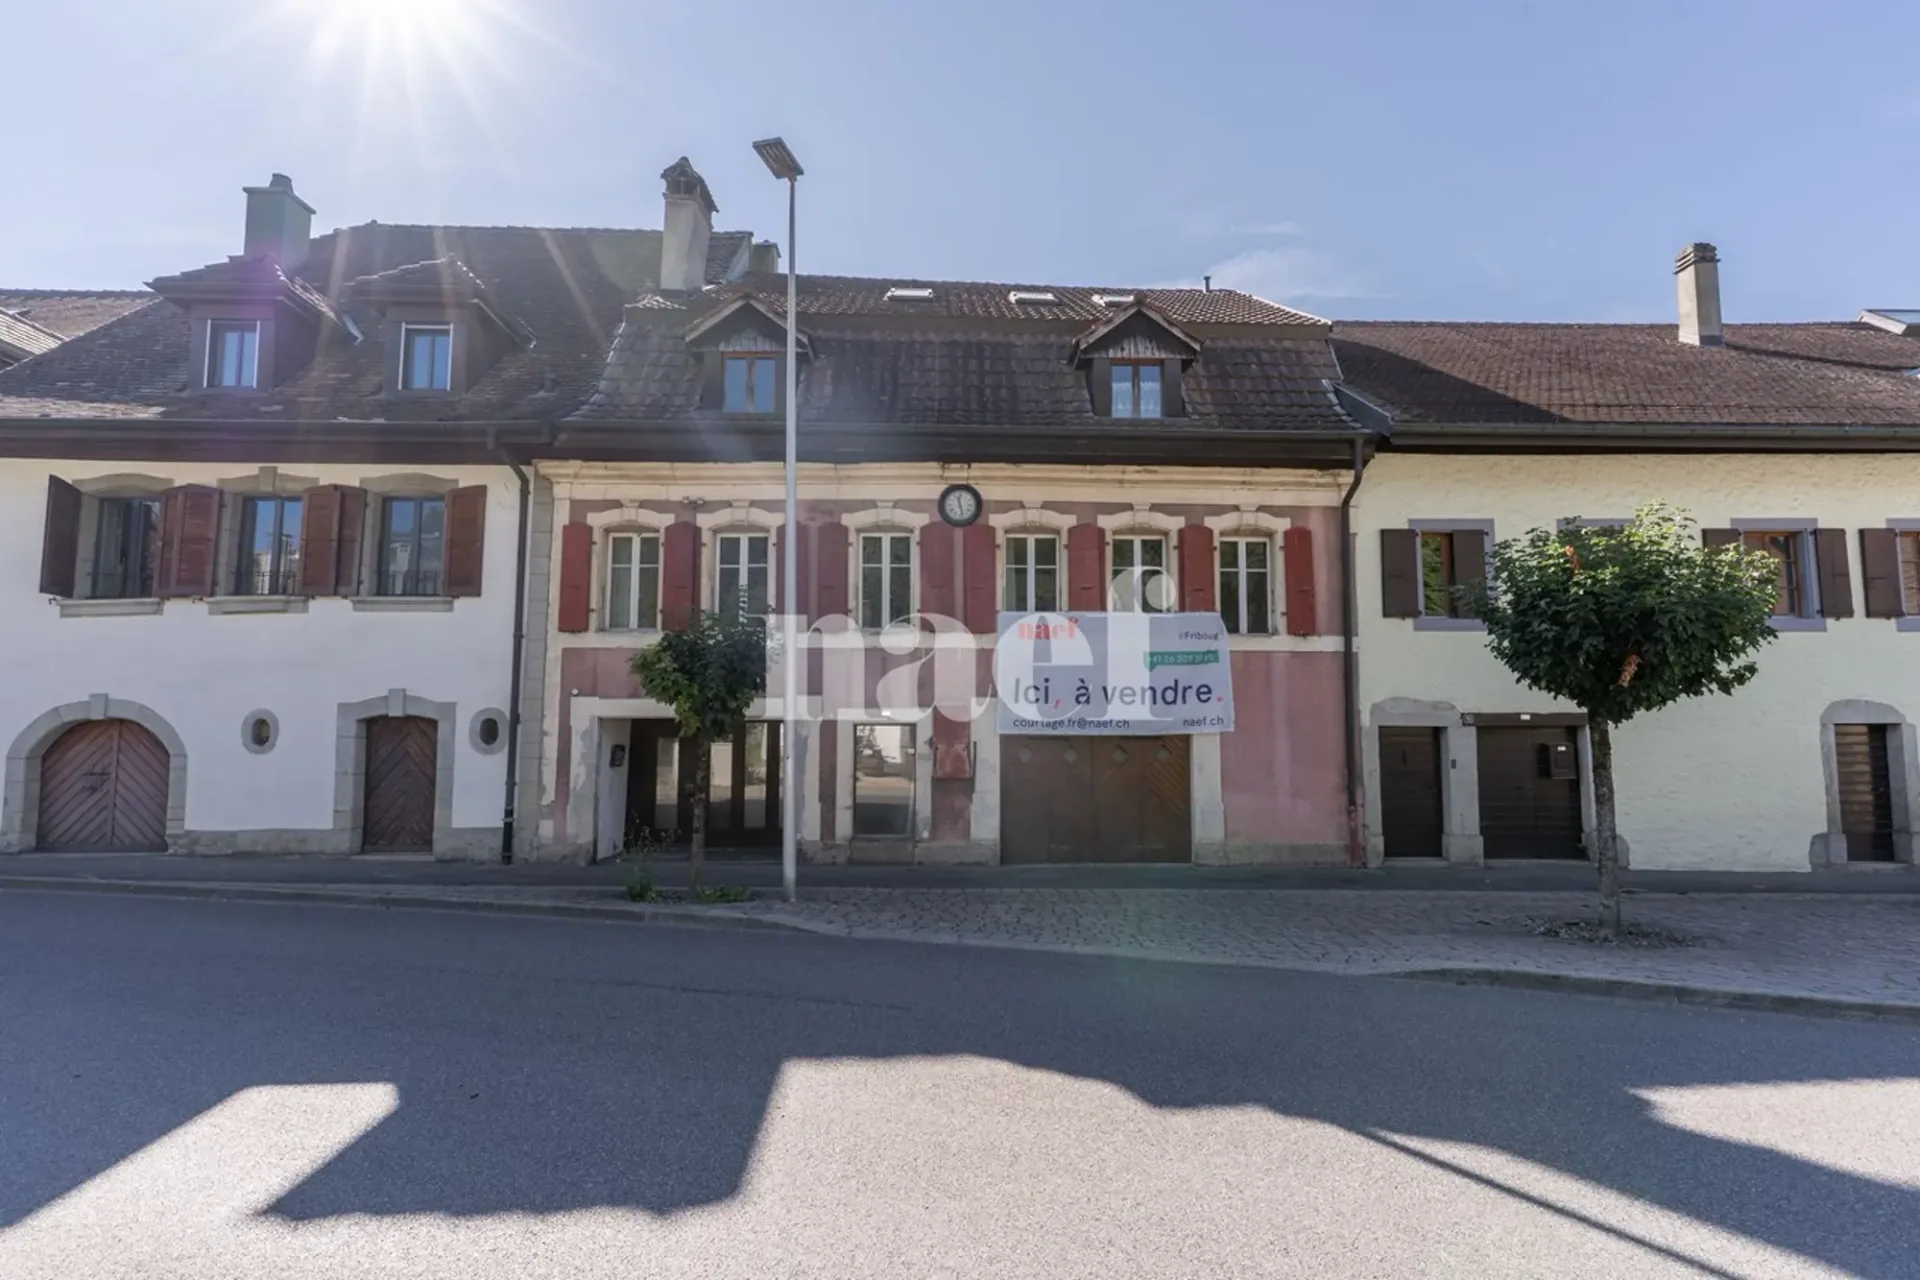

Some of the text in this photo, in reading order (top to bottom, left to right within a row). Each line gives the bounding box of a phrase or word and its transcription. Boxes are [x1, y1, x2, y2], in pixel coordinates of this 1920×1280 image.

[1013, 677, 1223, 709] Ici, à vendre.
[1012, 717, 1130, 729] courtage.fr@naef.ch
[1182, 716, 1225, 728] naef.ch
